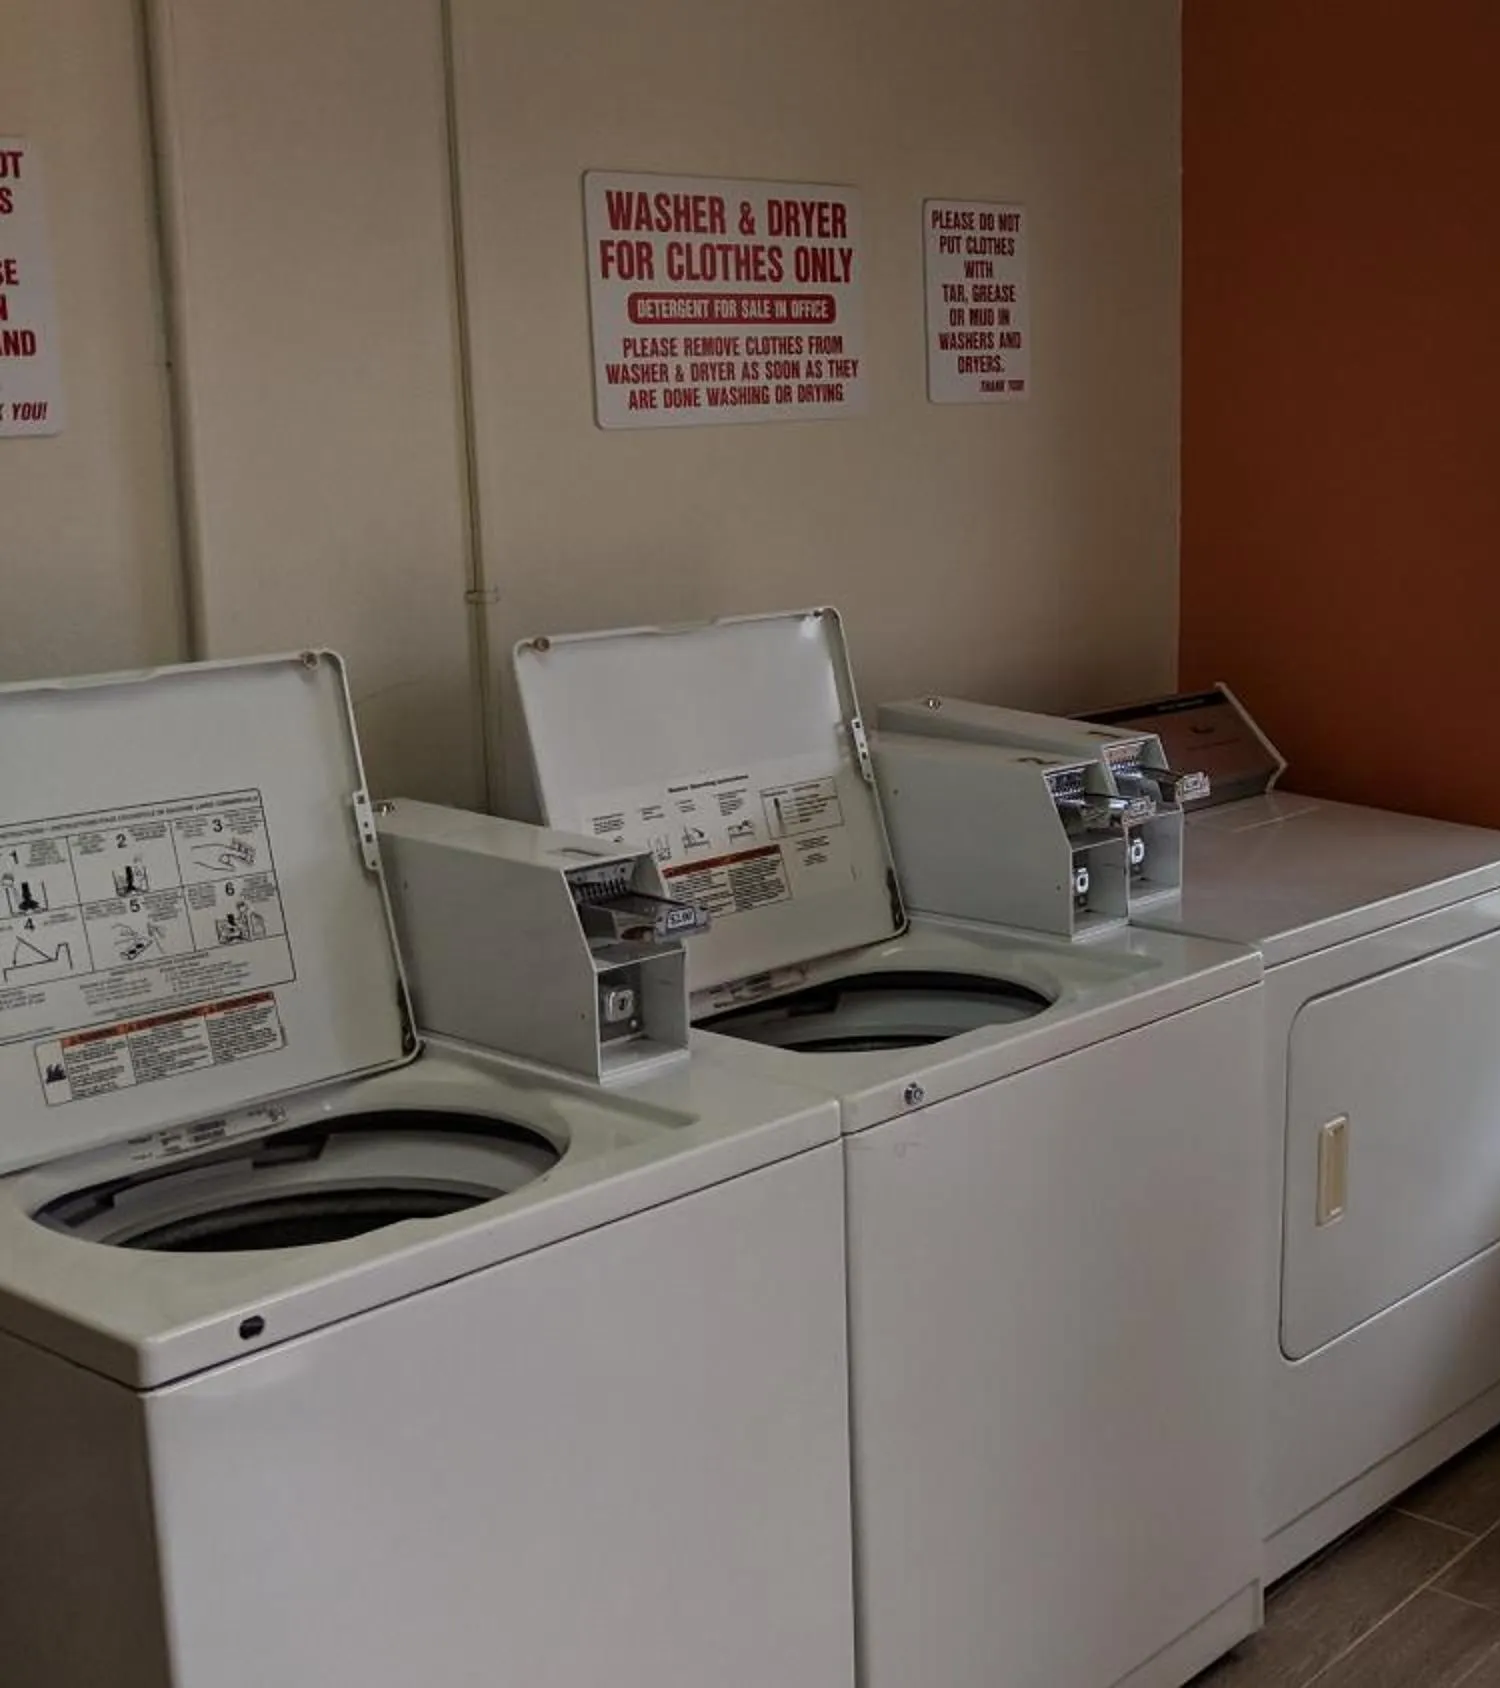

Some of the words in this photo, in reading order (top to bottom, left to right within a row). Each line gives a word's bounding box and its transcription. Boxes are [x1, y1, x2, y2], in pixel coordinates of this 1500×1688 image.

[606, 190, 725, 234] WASHER
[738, 201, 756, 236] &
[767, 200, 847, 238] DRYER
[932, 209, 974, 230] PLEASE
[980, 212, 994, 231] DO
[998, 213, 1021, 233] NOT
[939, 236, 962, 254] PUT
[966, 237, 1015, 256] CLOTHES
[599, 240, 654, 281] FOR
[666, 241, 783, 282] CLOTHES
[795, 247, 853, 283] ONLY
[964, 260, 993, 279] WITH
[942, 284, 968, 304] TAR,
[972, 285, 1016, 302] GREASE
[638, 299, 709, 319] DETERGENT
[714, 300, 737, 318] FOR
[741, 299, 770, 318] SALE
[775, 300, 788, 318] IN
[791, 300, 828, 319] OFFICE
[949, 308, 965, 326] OR
[969, 309, 994, 326] MUD
[998, 309, 1010, 326] IN
[623, 338, 677, 358] PLEASE
[684, 337, 740, 357] REMOVE
[745, 337, 803, 356] CLOTHES
[808, 336, 843, 354] FROM
[938, 332, 994, 350] WASHERS
[999, 333, 1021, 350] AND
[606, 364, 669, 384] WASHER
[675, 365, 684, 382] &
[691, 362, 735, 382] DRYER
[742, 362, 759, 381] AS
[766, 361, 800, 380] SOON
[805, 360, 823, 379] AS
[827, 359, 859, 378] THEY
[629, 389, 657, 410] ARE
[664, 388, 701, 408] DONE
[707, 386, 770, 407] WASHING
[775, 385, 792, 404] OR
[797, 384, 844, 402] DRYING
[12, 402, 48, 422] YOU!
[212, 819, 223, 833] 3
[116, 833, 127, 848] 2
[10, 850, 19, 864] 1
[225, 882, 235, 897] 6
[129, 899, 141, 912] 5
[24, 918, 35, 931] 4
